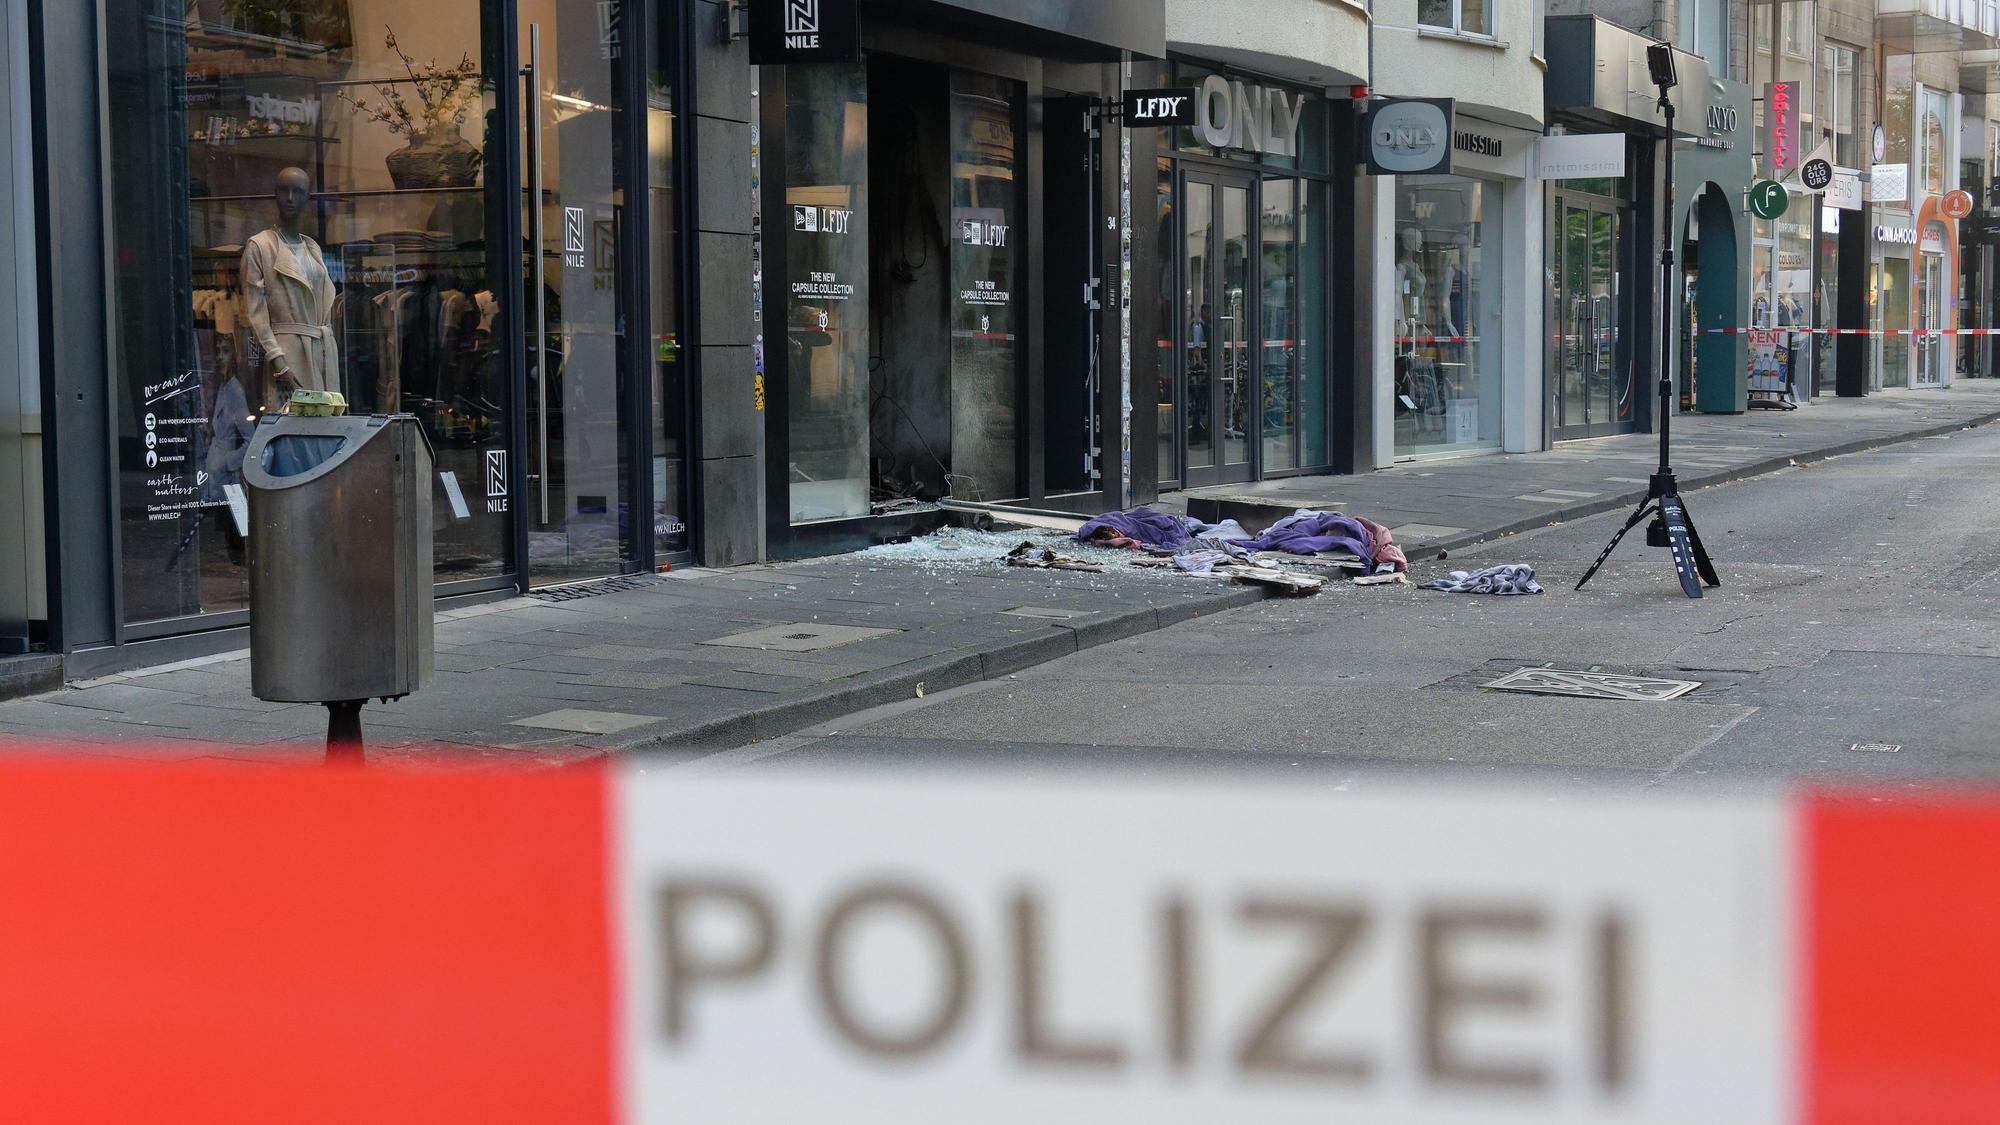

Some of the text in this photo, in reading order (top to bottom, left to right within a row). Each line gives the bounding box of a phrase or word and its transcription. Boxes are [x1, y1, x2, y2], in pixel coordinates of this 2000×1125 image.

[785, 35, 819, 49] NILE
[1196, 75, 1304, 157] ONLY
[1375, 127, 1440, 149] ONLY
[1542, 162, 1621, 173] intimissimi
[1807, 162, 1825, 172] 24C
[1808, 169, 1826, 179] OLO
[1809, 176, 1828, 186] URS
[1107, 216, 1116, 230] 34
[1878, 225, 1918, 244] CINNAMOOD
[566, 255, 584, 267] NILE
[810, 272, 835, 282] THE NEW
[792, 283, 854, 295] CAPSULE COLLECTION
[975, 281, 996, 291] THE NEW
[960, 290, 1009, 301] CAPSULE COLLECTION
[145, 371, 192, 398] we care
[147, 474, 183, 487] earth
[155, 484, 198, 496] matters
[147, 504, 161, 512] Dieser
[161, 503, 172, 511] Store
[172, 502, 181, 510] wird
[188, 501, 199, 509] 100%
[487, 499, 507, 513] NILE
[655, 876, 1637, 1098] POLIZEI
